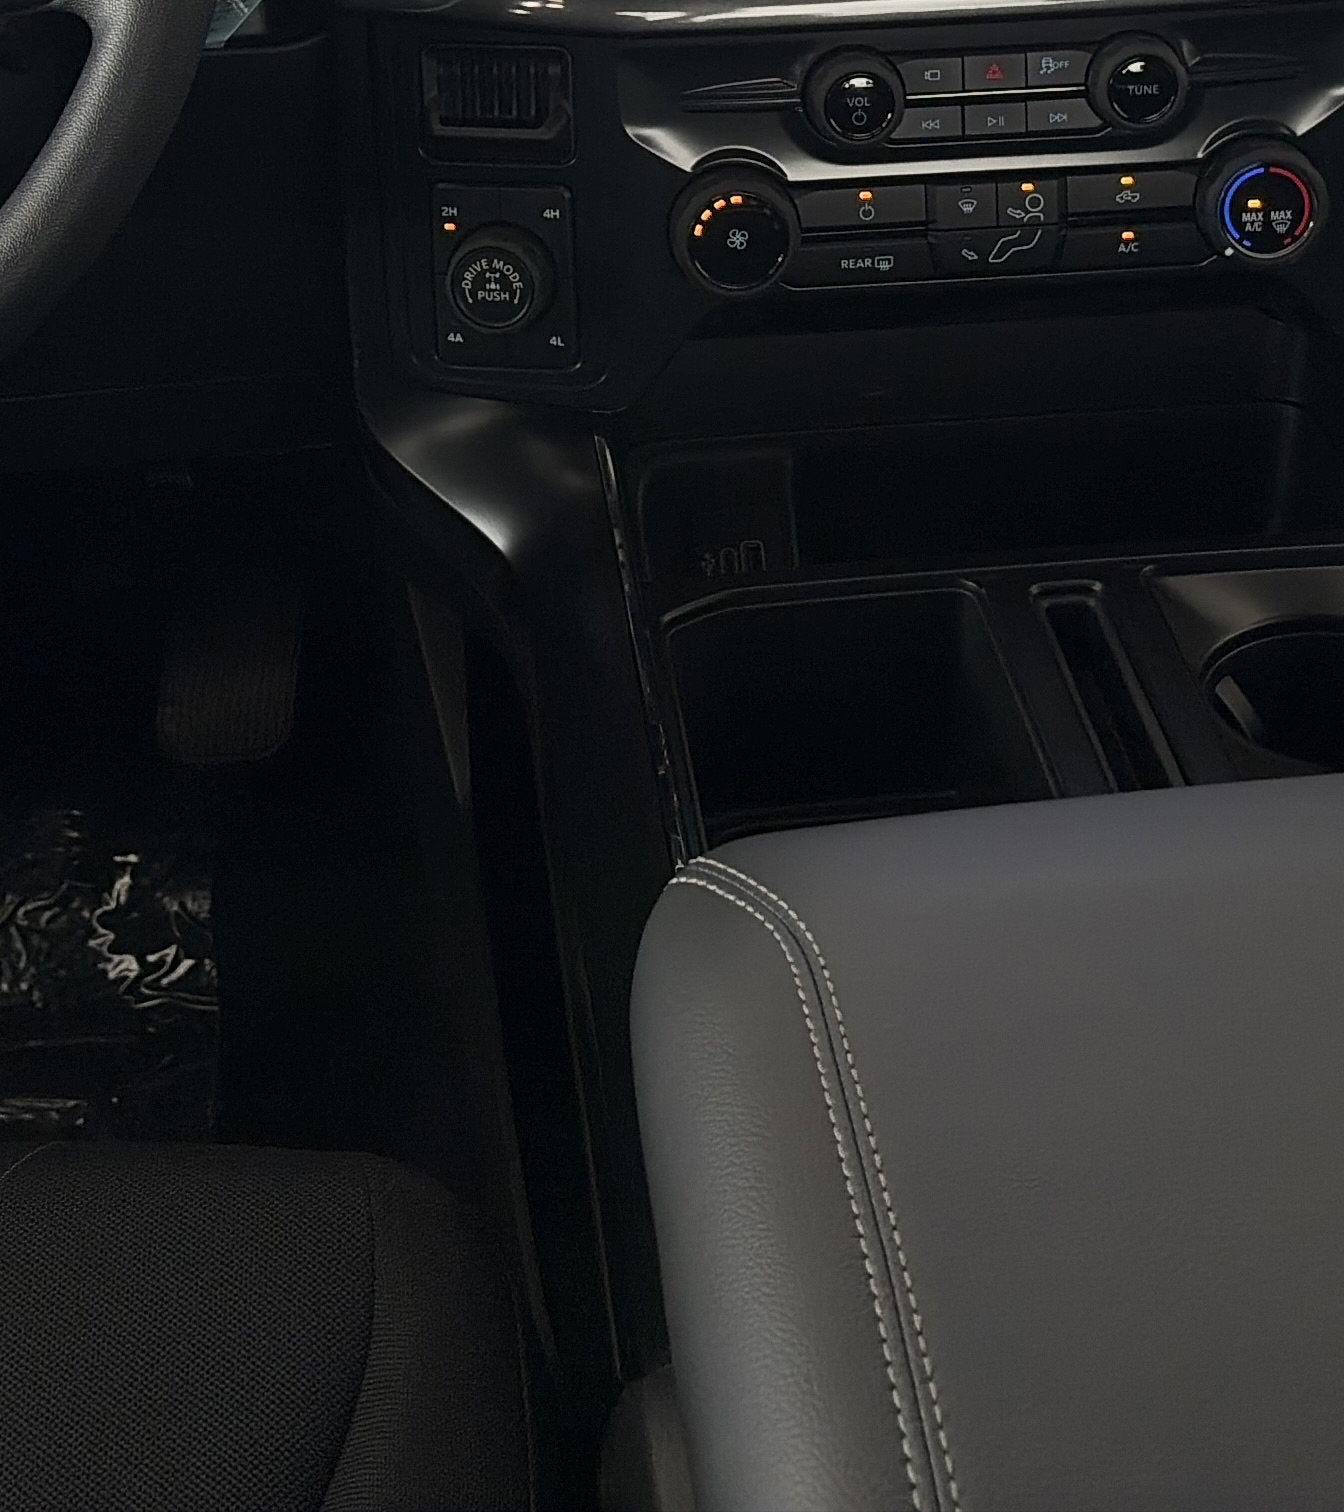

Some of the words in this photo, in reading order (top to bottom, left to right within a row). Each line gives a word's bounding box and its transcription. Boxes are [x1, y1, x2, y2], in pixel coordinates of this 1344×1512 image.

[1052, 59, 1071, 71] OFF
[1127, 83, 1160, 96] TUNE
[846, 96, 871, 108] VOL
[441, 206, 458, 217] 2H
[542, 208, 560, 220] 4H
[1241, 211, 1265, 223] MAX
[1270, 209, 1293, 221] MAX
[1244, 222, 1263, 233] A/C
[1118, 241, 1140, 254] A/C
[841, 258, 873, 270] REAR
[461, 258, 490, 290] DRIVE
[491, 257, 524, 290] MODE
[476, 290, 510, 302] PUSH
[446, 332, 464, 343] 4A
[549, 336, 565, 348] 4L
